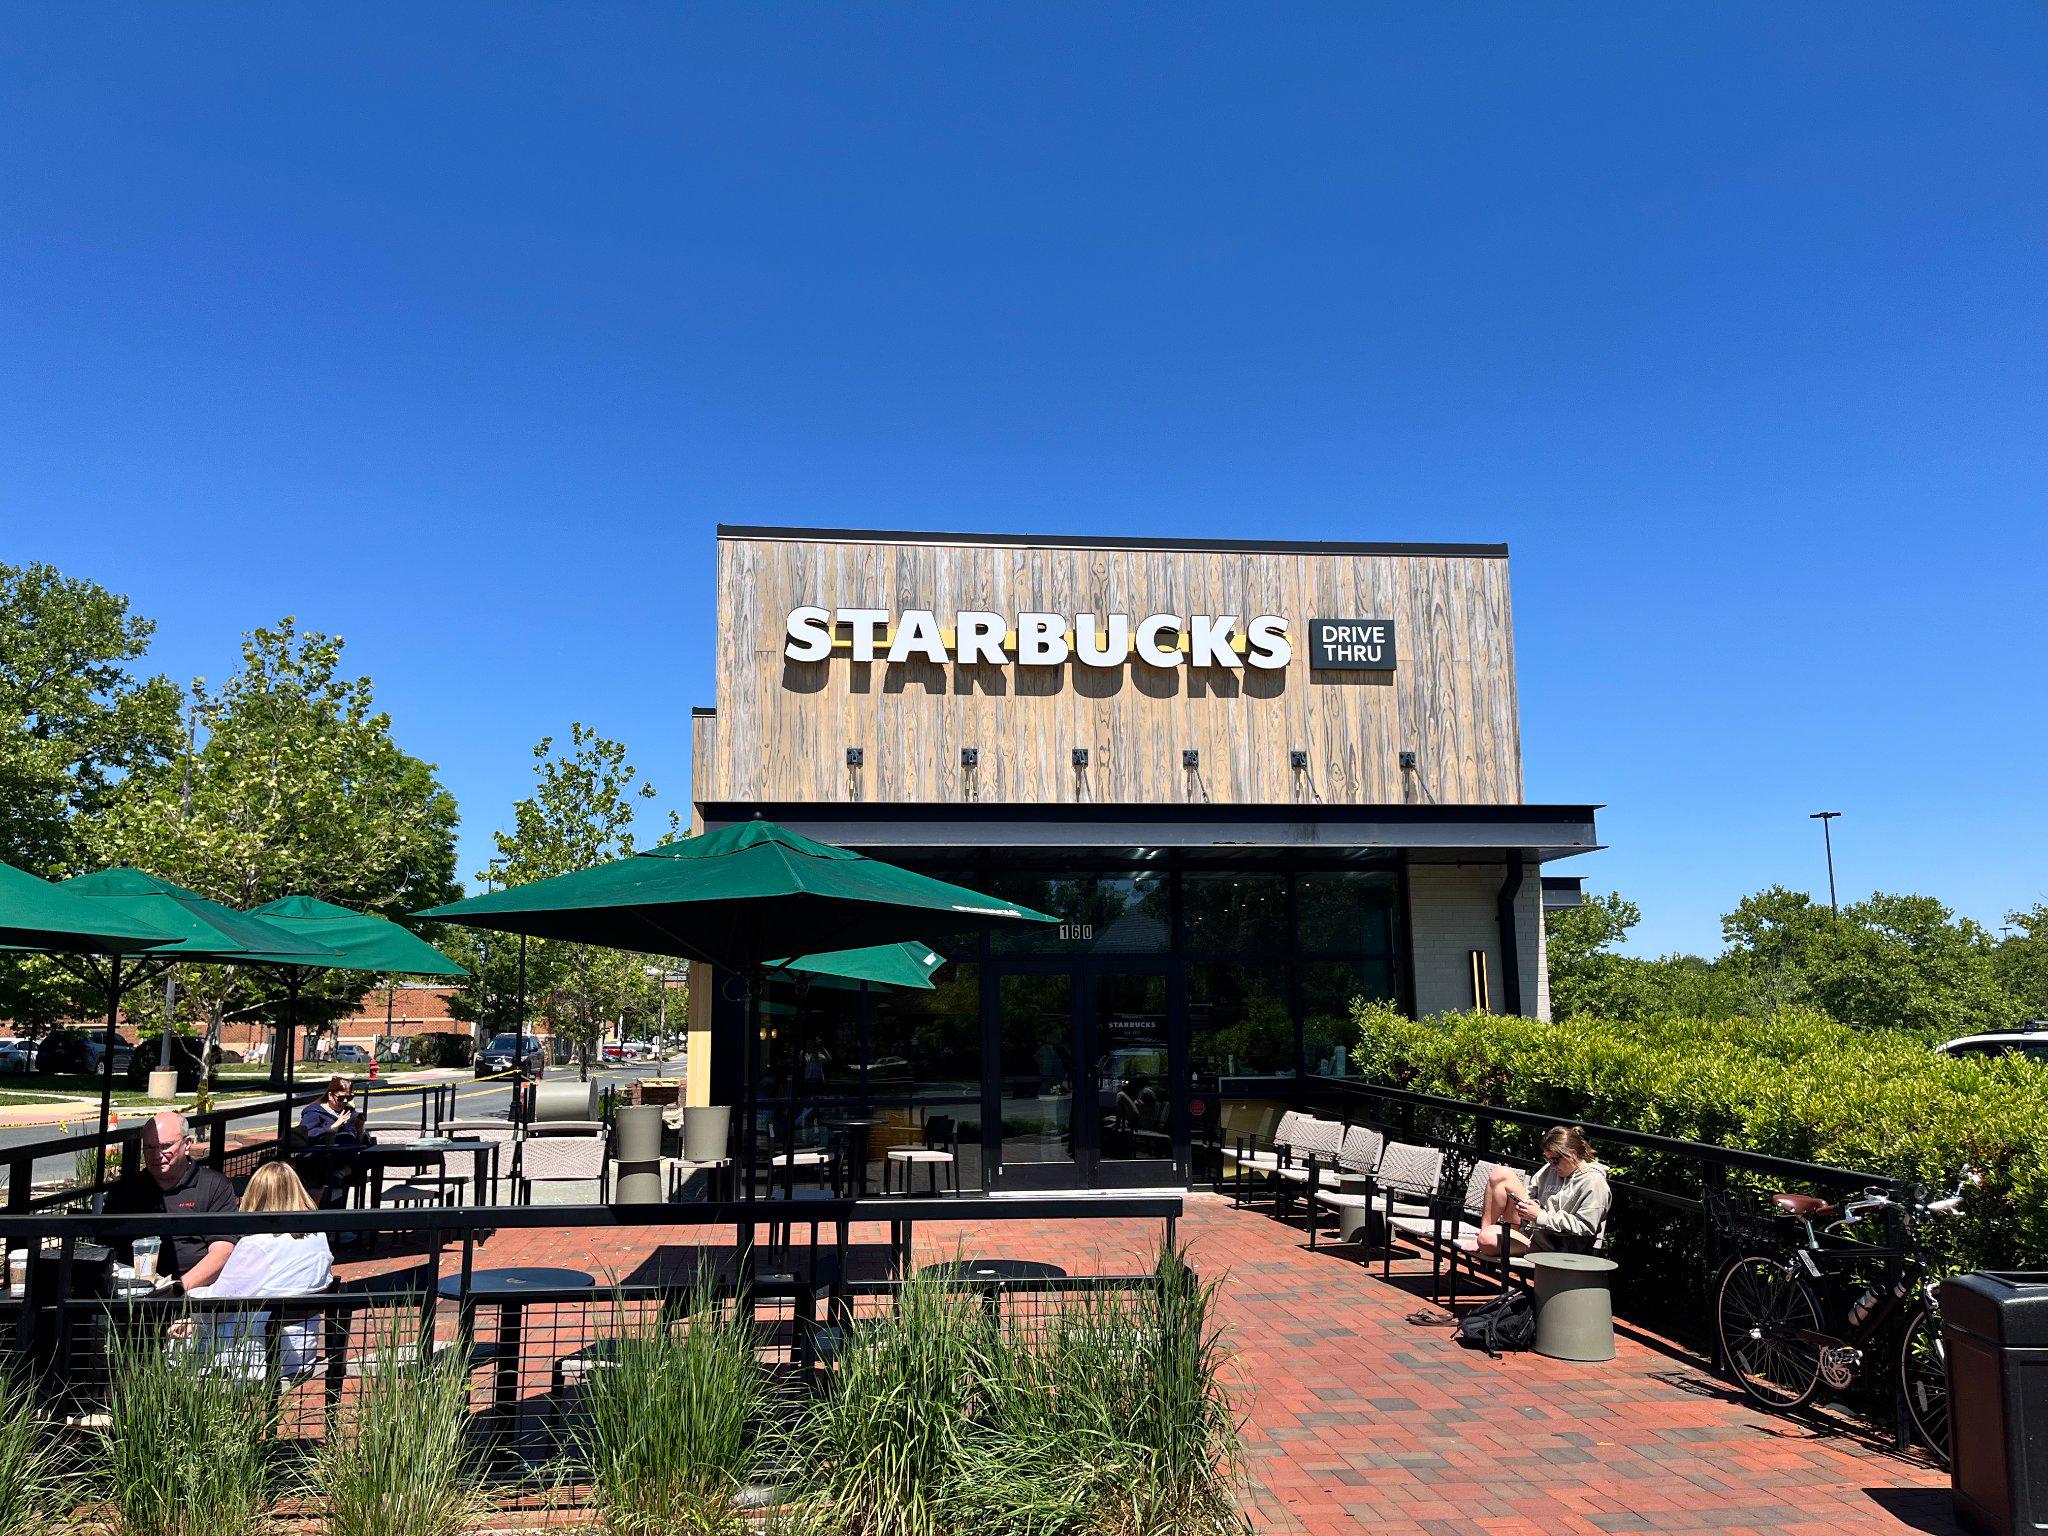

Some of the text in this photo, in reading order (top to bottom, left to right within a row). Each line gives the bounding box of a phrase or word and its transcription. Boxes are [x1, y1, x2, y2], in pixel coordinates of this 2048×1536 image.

[784, 605, 1293, 670] STARBUCKS
[1322, 625, 1386, 644] DRIVE
[1323, 644, 1382, 662] THRU
[1059, 924, 1093, 940] 160
[1108, 1021, 1156, 1029] STARBUCKS
